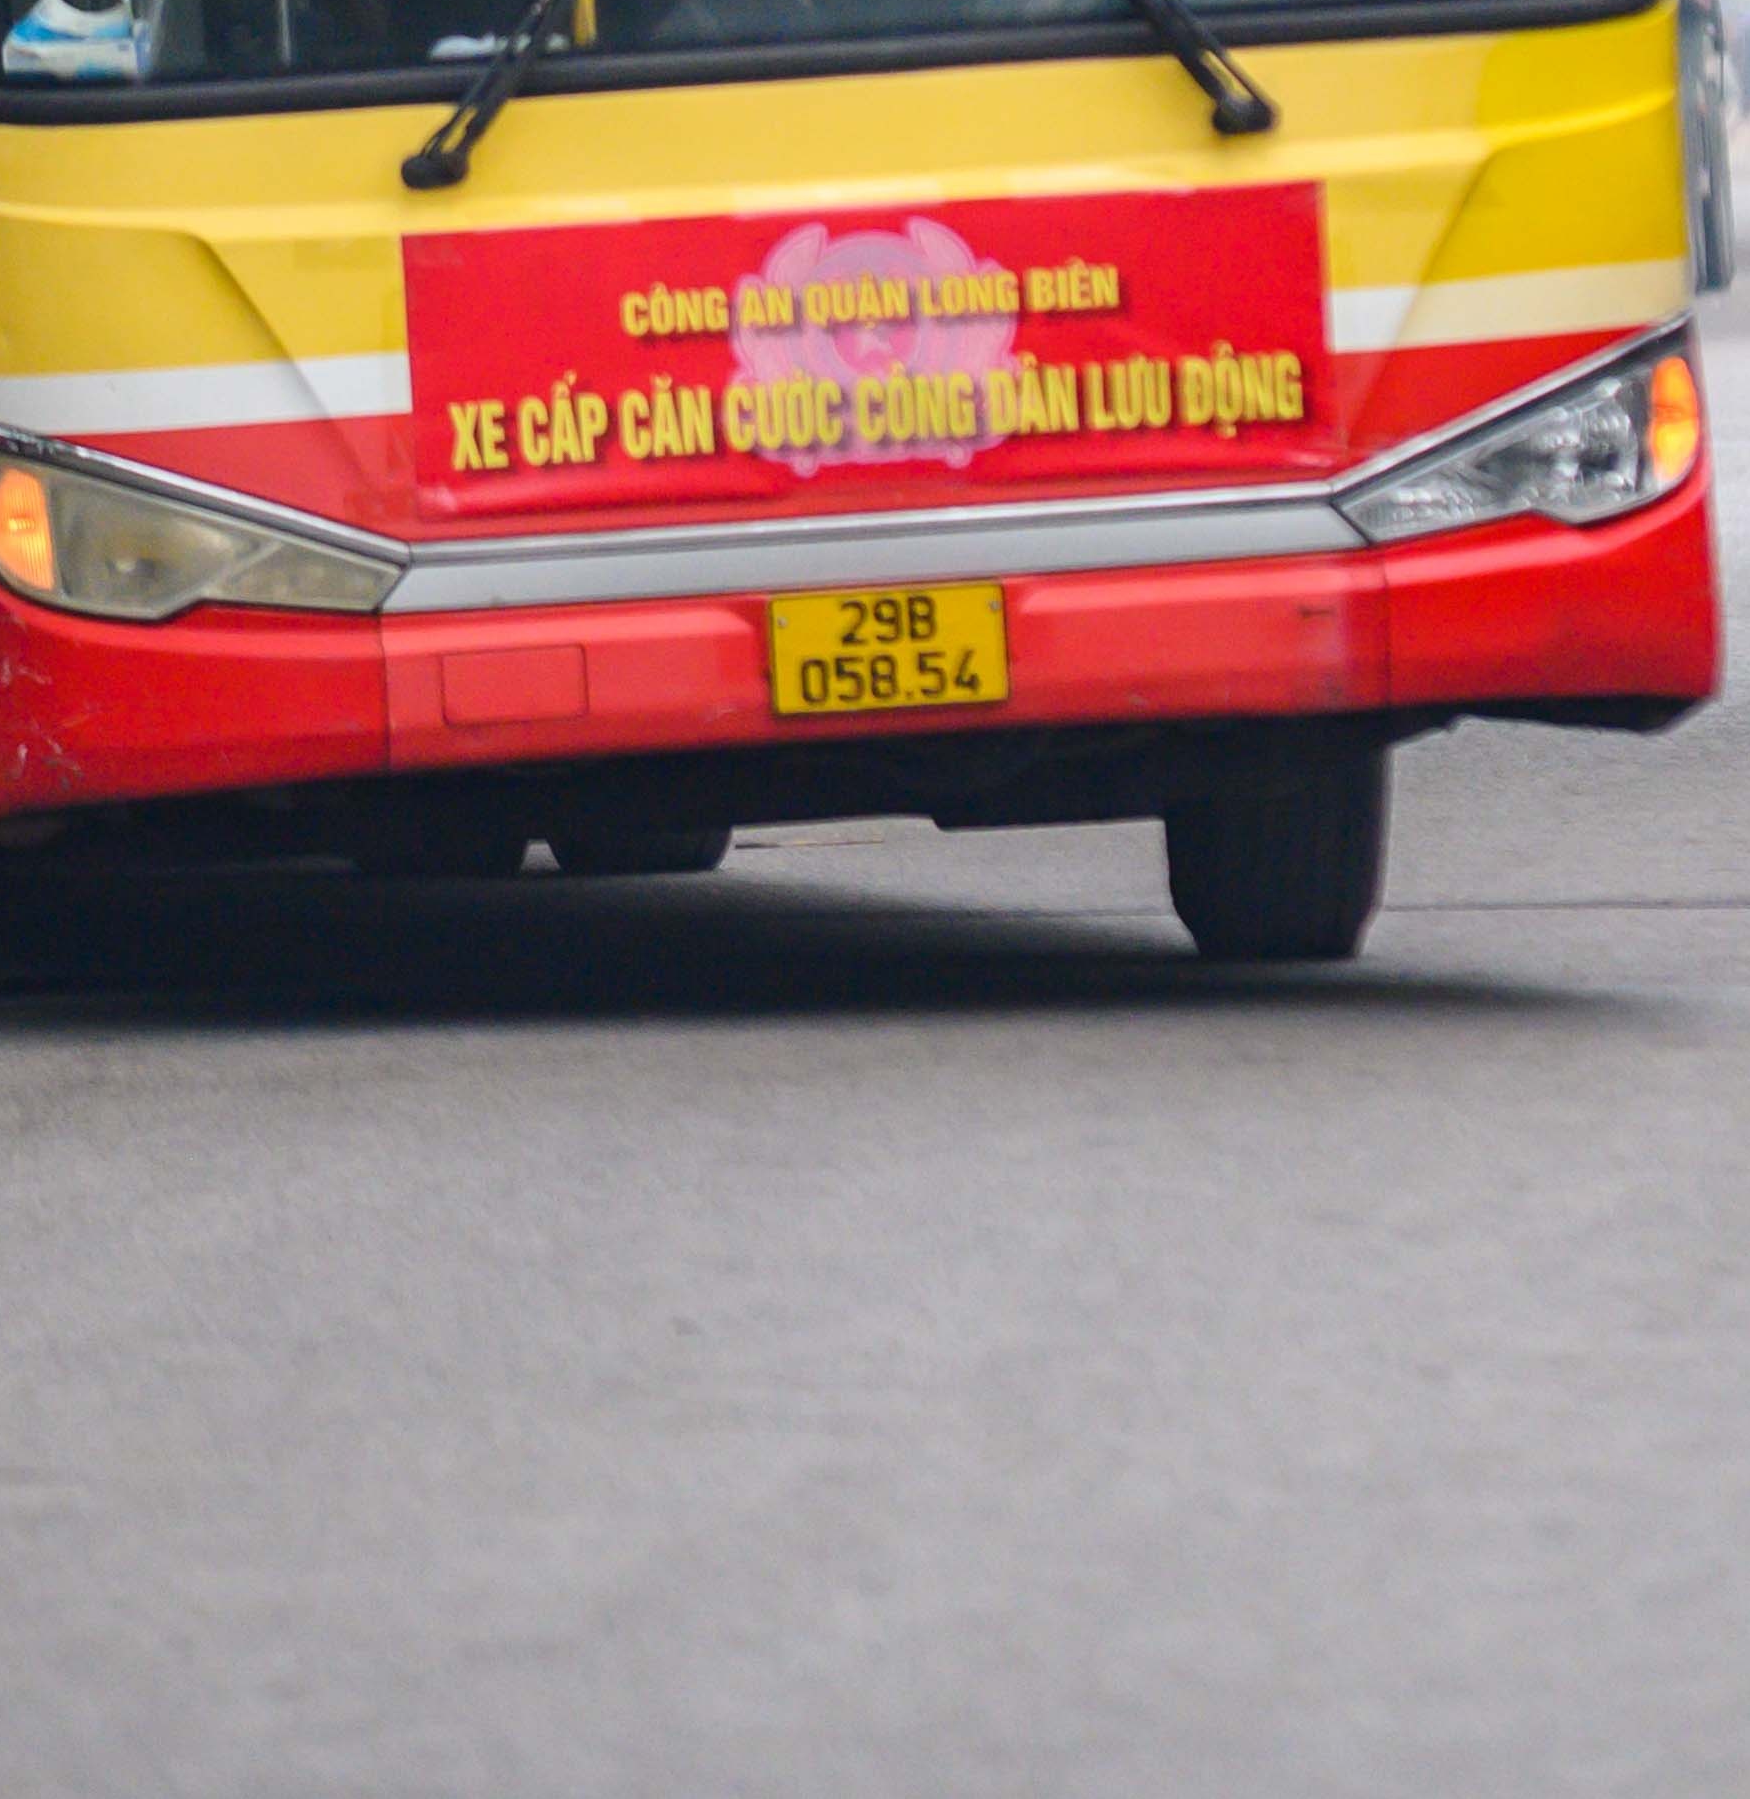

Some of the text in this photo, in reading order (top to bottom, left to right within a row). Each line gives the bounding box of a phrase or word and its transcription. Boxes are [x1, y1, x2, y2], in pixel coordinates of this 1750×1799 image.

[621, 255, 1120, 338] CÔNG AN QUẬN LONG BIÊN
[449, 338, 1305, 471] XE CẤP CĂN CƯỚC CÔNG DÂN LƯU ĐỘNG
[840, 595, 936, 646] 29B
[801, 648, 981, 705] 058.54
